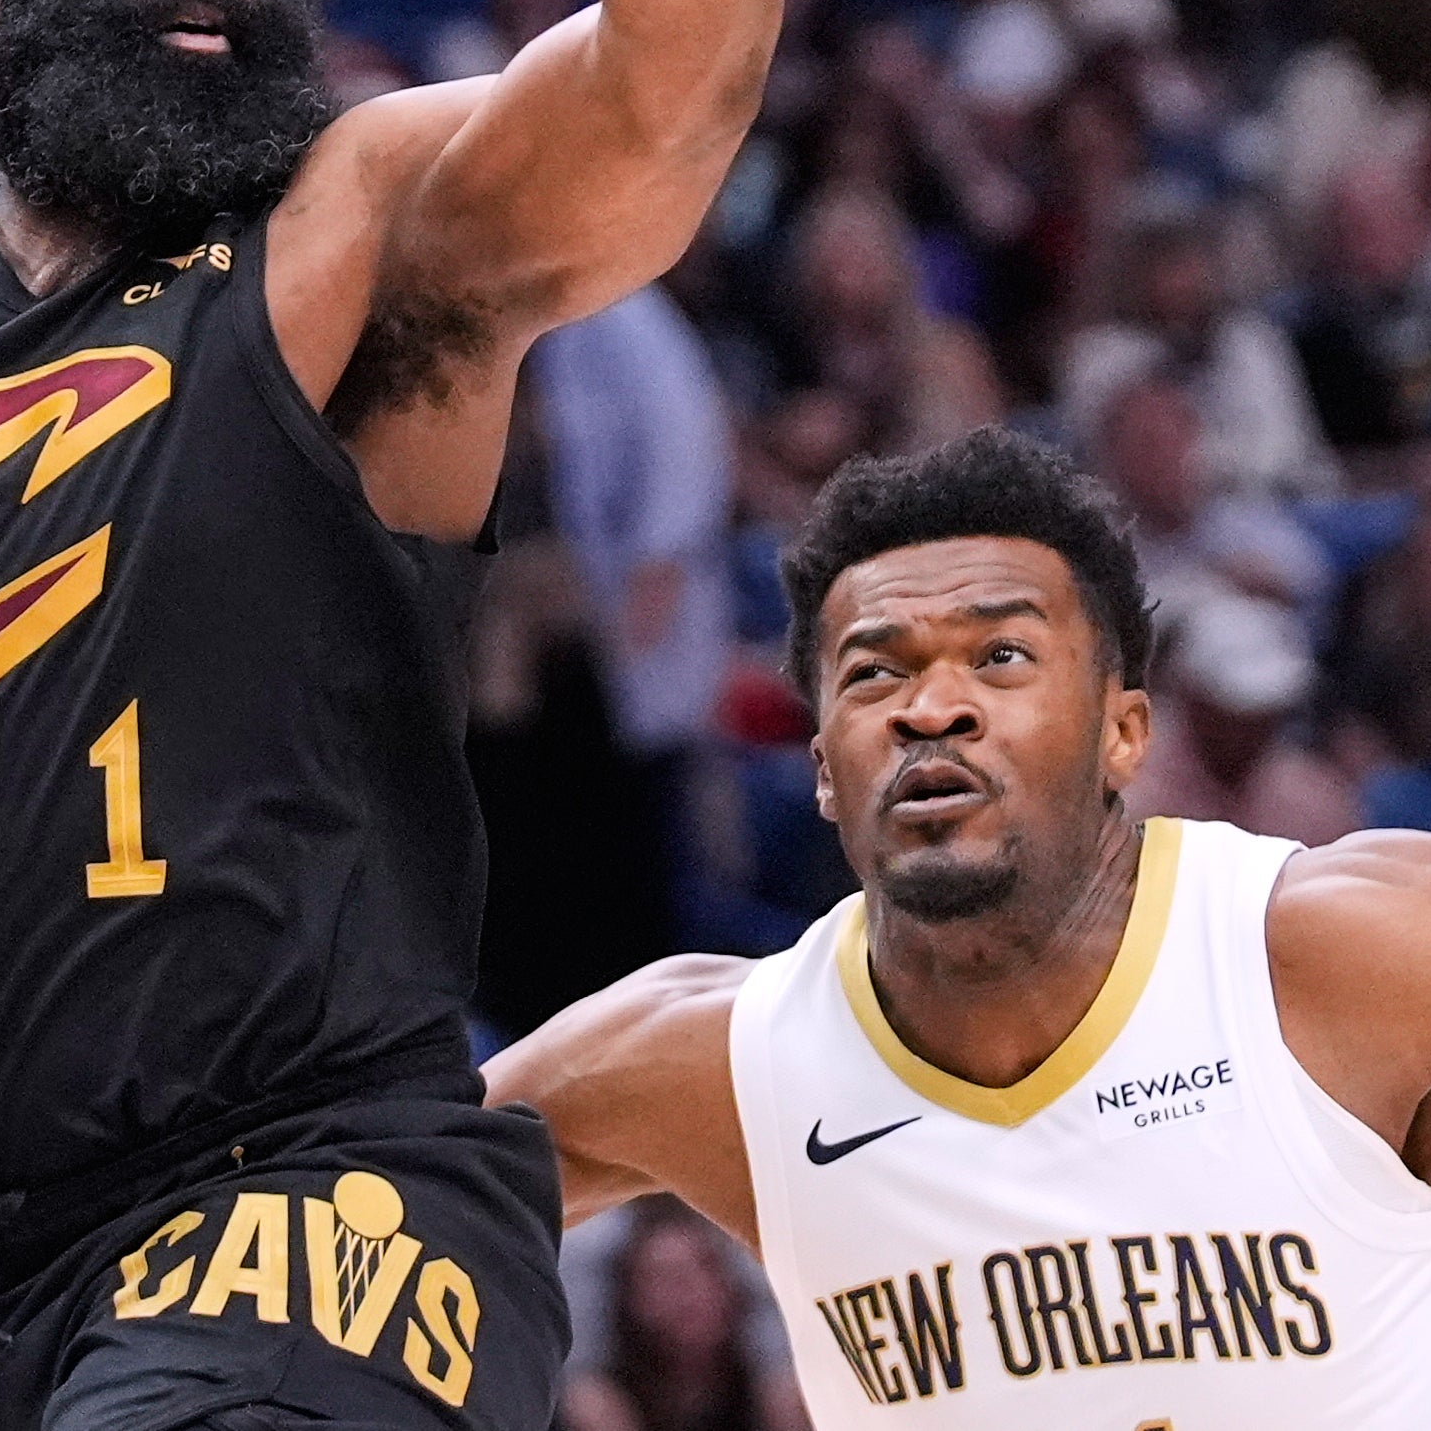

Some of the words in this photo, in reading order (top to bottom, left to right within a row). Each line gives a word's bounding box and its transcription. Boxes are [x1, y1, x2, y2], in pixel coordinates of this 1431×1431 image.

[122, 242, 233, 306] CLFS
[86, 699, 167, 899] 1
[1095, 1059, 1233, 1114] NEWAGE
[1134, 1099, 1206, 1128] GRILLS
[113, 1171, 481, 1408] CAVS
[815, 1260, 966, 1406] NEW
[981, 1232, 1335, 1378] ORLEANS
